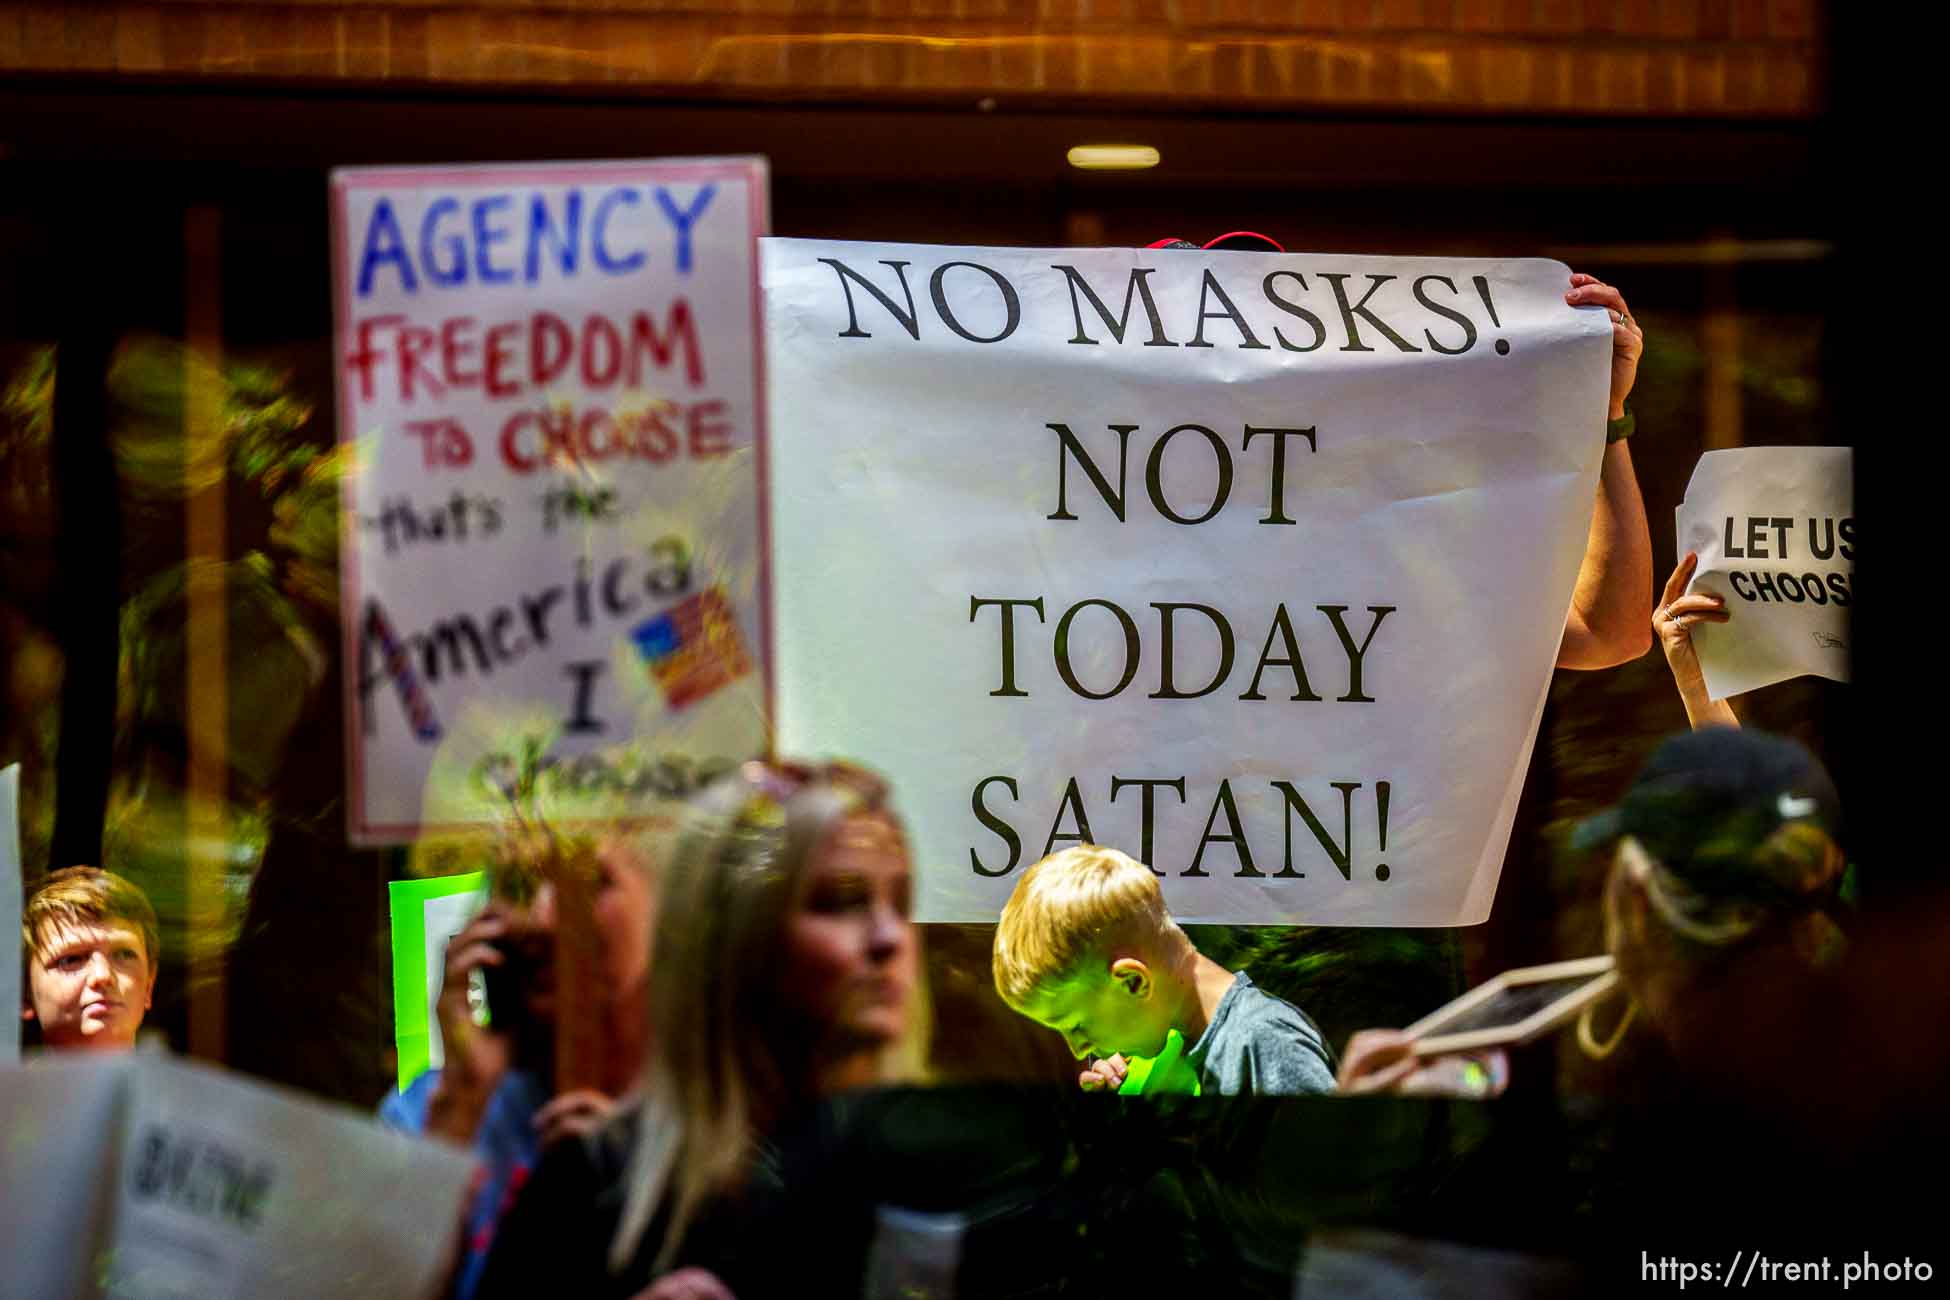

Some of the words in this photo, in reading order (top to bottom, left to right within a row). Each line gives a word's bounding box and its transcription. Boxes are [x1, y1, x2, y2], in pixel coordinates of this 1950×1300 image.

[357, 184, 720, 298] AGENCY
[347, 298, 706, 400] FREEDOM
[817, 257, 1022, 345] NO
[1051, 264, 1512, 357] MASKS!
[497, 400, 736, 474] CHOOSE
[1045, 423, 1318, 526] NOT
[1724, 516, 1794, 560] LET
[1808, 517, 1857, 561] US
[1729, 570, 1853, 608] CHOOS
[358, 534, 694, 742] America
[970, 595, 1397, 703] TODAY
[562, 659, 605, 734] I
[969, 774, 1392, 882] SATAN!
